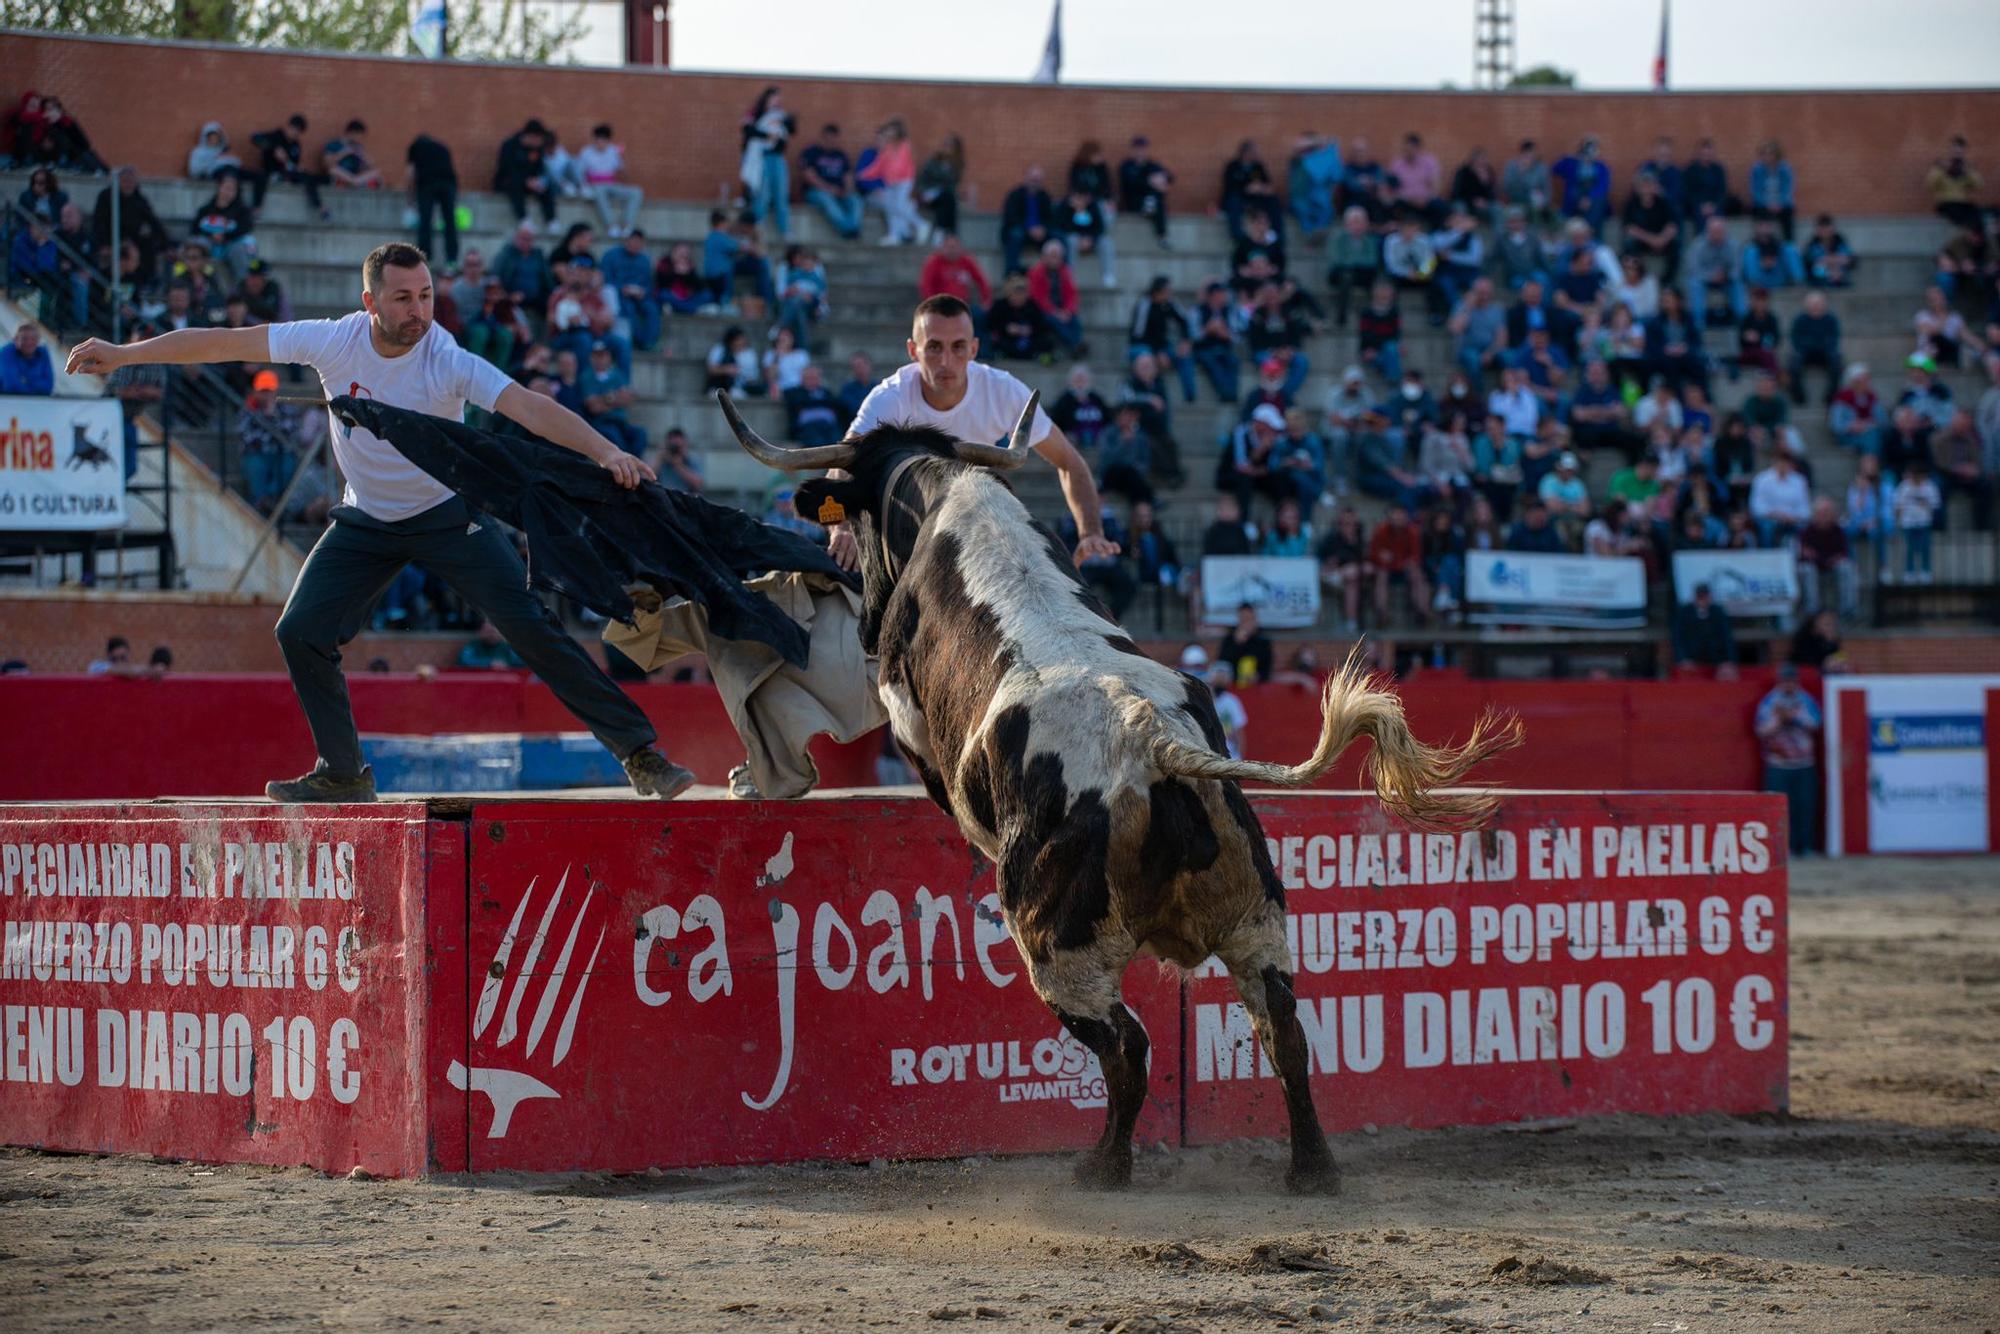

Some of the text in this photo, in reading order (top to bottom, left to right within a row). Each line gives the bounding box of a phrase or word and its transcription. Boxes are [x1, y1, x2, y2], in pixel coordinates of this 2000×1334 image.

[32, 494, 117, 514] CULTURA
[0, 842, 171, 898] PECIALIDAD
[224, 841, 356, 900] PAELLAS
[1529, 825, 1581, 881] EN
[1593, 821, 1770, 878] PAELLAS
[0, 921, 132, 985] MUERZO
[141, 923, 295, 989] POPULAR
[304, 925, 328, 991] 6
[1470, 898, 1688, 965] POPULAR
[1699, 896, 1732, 955] 6
[1740, 895, 1775, 953] €
[0, 1005, 361, 1104] ENU DIARIO 10 €
[1196, 975, 1775, 1082] MNU DIARIO 10 €
[891, 1039, 1088, 1086] ROTULOS
[1000, 1078, 1109, 1103] LEVANTE.C
